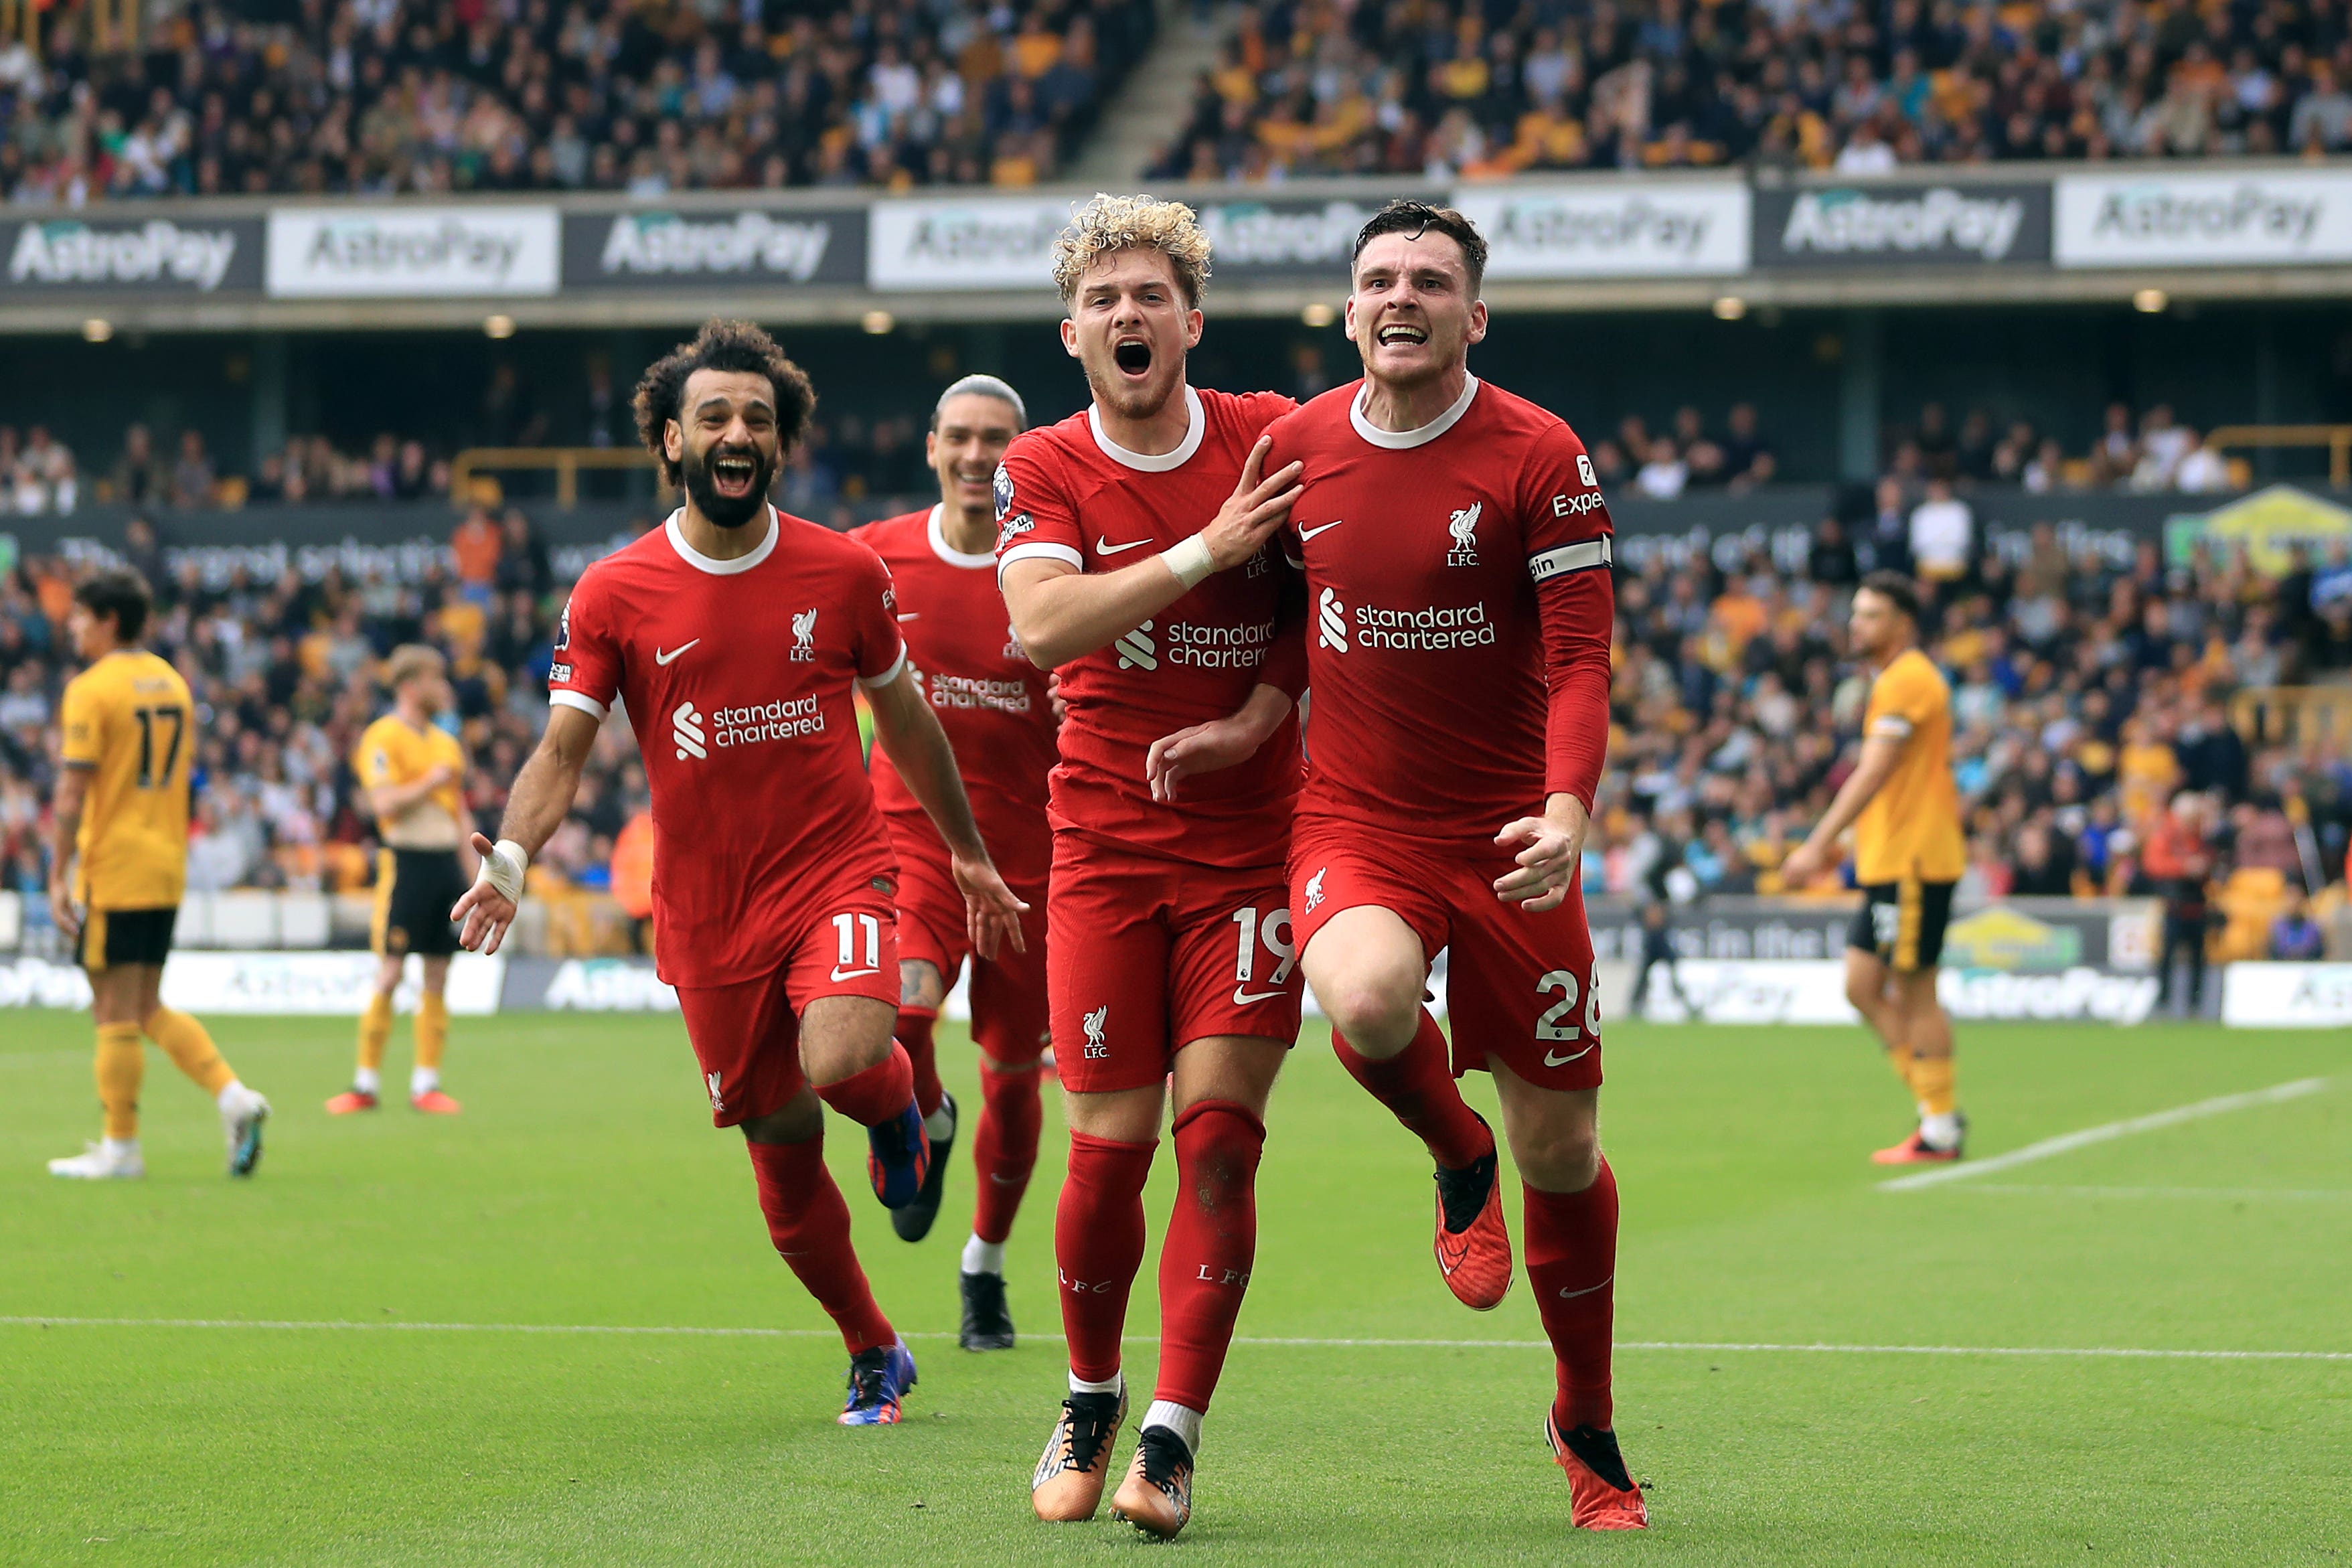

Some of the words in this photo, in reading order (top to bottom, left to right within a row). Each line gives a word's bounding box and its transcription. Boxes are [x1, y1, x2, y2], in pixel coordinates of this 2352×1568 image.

[309, 218, 523, 284] AstroPay
[601, 211, 831, 281] AstroPay
[905, 209, 1059, 261] AstroP
[1492, 192, 1713, 261] AstroPay
[1783, 188, 2023, 260] AstroPay
[2095, 187, 2321, 254] AstroPay
[9, 219, 236, 291] AstroPay
[1356, 601, 1485, 629] standard
[1358, 623, 1496, 651] chartered
[712, 692, 817, 728] standard
[931, 674, 1026, 697] standard
[931, 690, 1030, 712] chartered
[135, 706, 183, 788] 17
[715, 712, 825, 748] chartered
[832, 913, 880, 969] 11
[1233, 907, 1298, 985] 19
